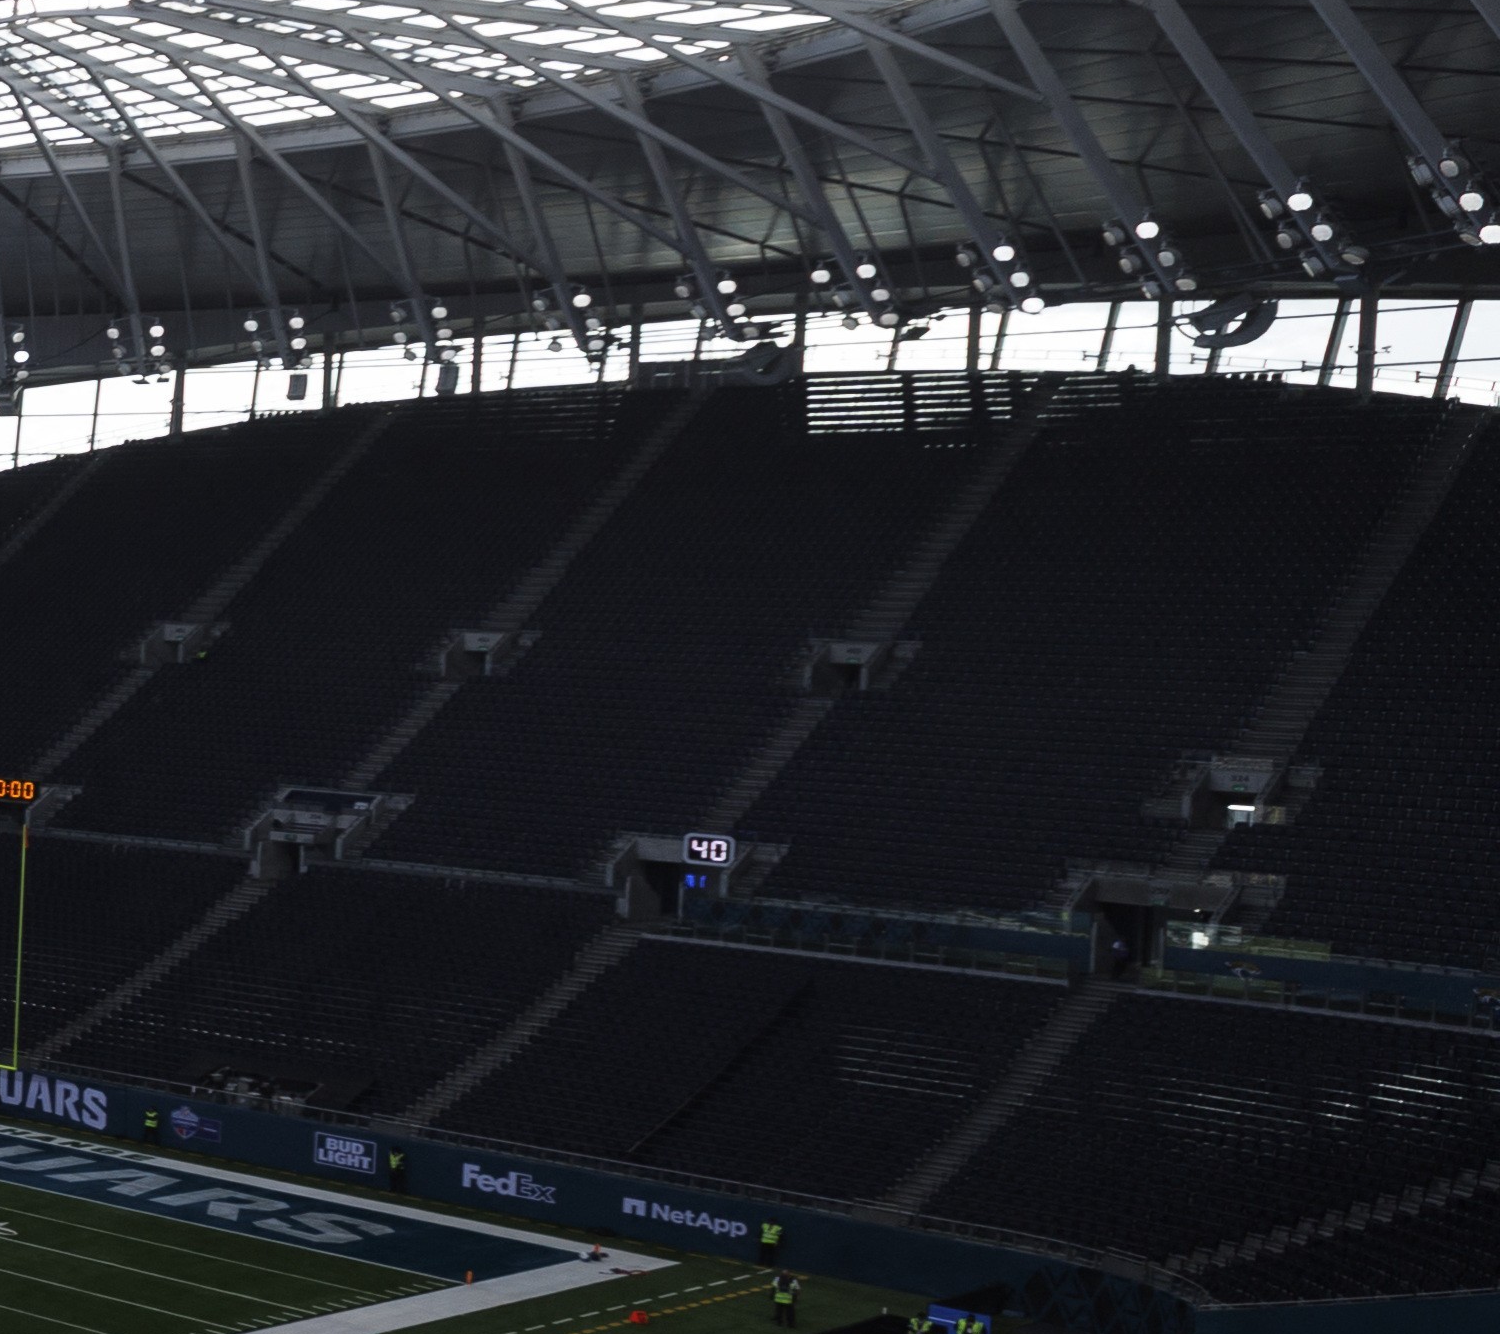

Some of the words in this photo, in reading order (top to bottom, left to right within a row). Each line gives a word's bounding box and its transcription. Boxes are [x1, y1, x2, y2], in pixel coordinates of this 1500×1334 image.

[691, 839, 728, 862] 40
[325, 1137, 365, 1156] BUD
[318, 1148, 372, 1170] LIGHT
[462, 1162, 557, 1205] FedEx
[651, 1202, 748, 1239] NetApp
